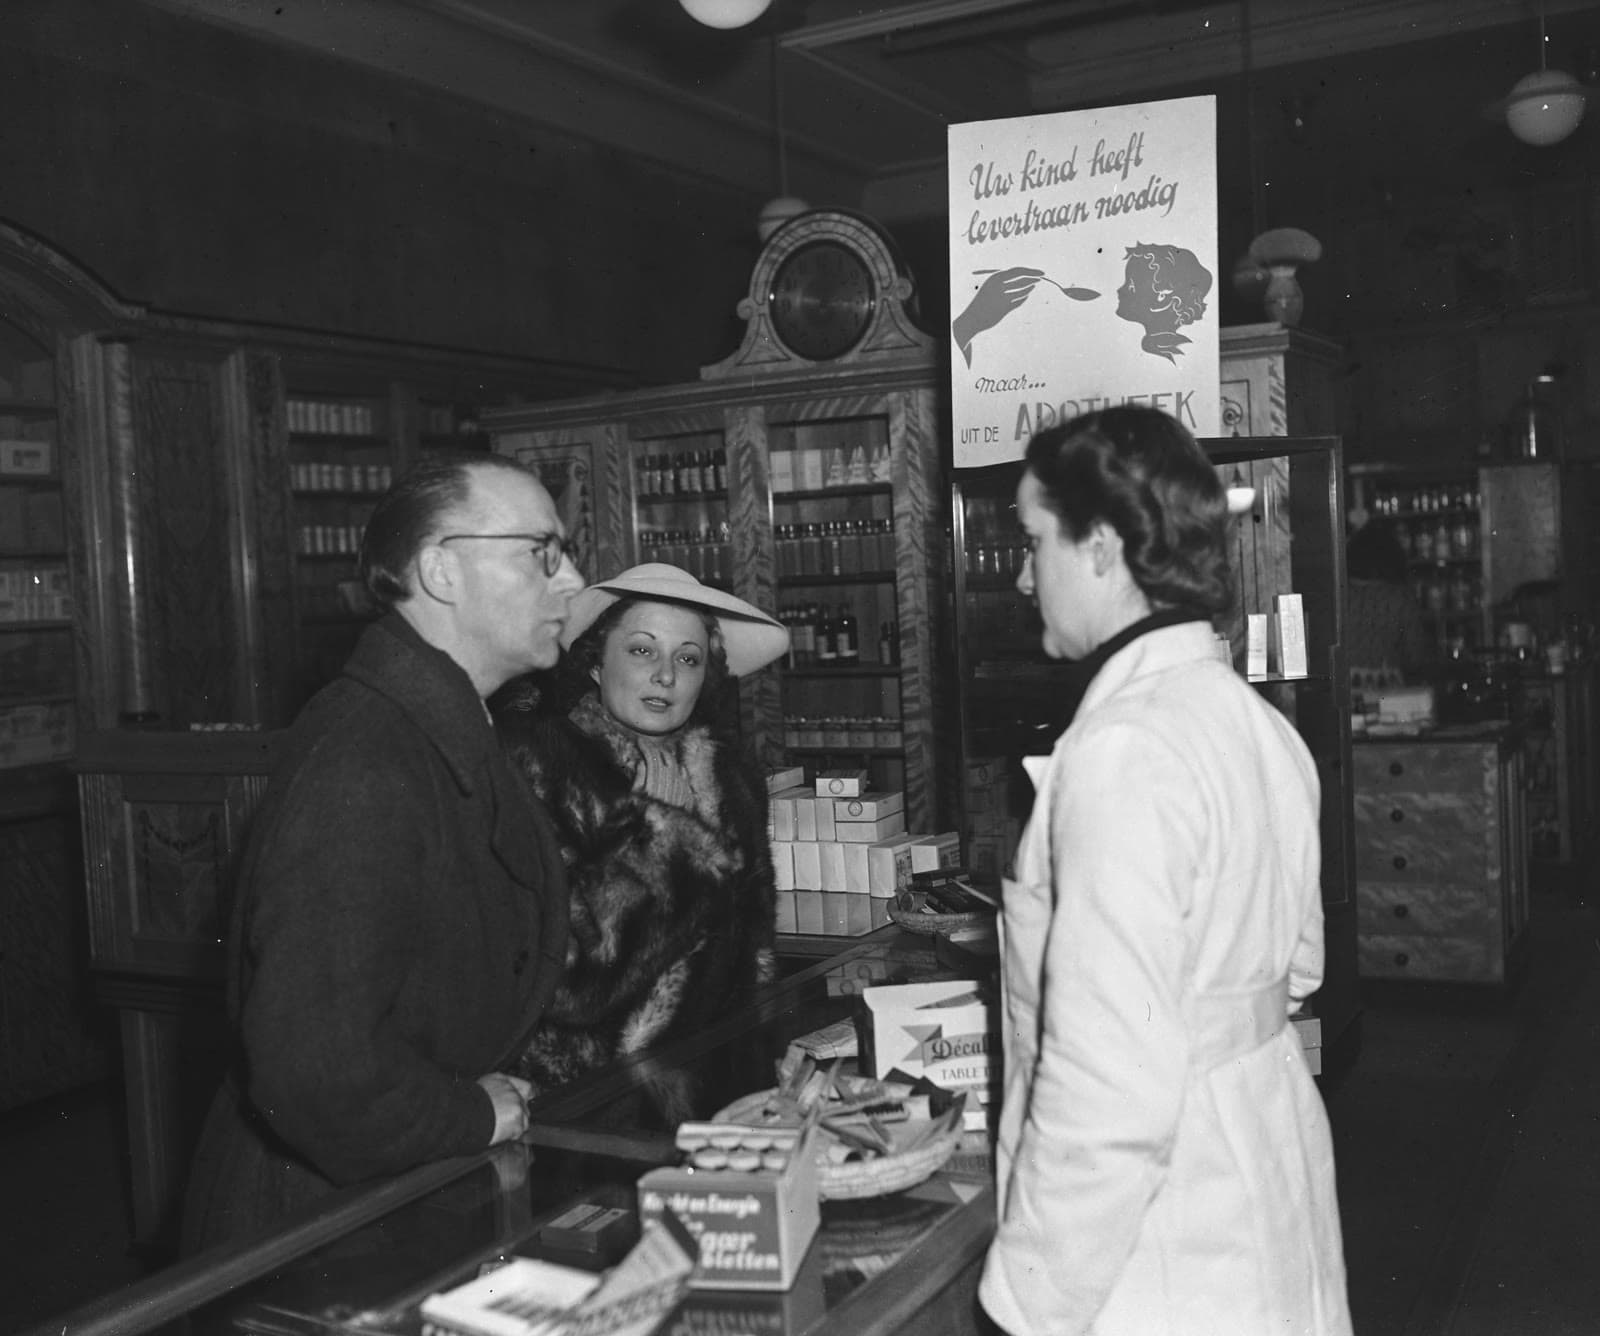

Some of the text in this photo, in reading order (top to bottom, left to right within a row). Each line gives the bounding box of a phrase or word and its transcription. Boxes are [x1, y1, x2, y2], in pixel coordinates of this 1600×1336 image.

[969, 131, 1145, 200] Uw kind heeft
[961, 174, 1179, 245] levertraan noodig
[961, 389, 1198, 444] UIT DE APOTEK
